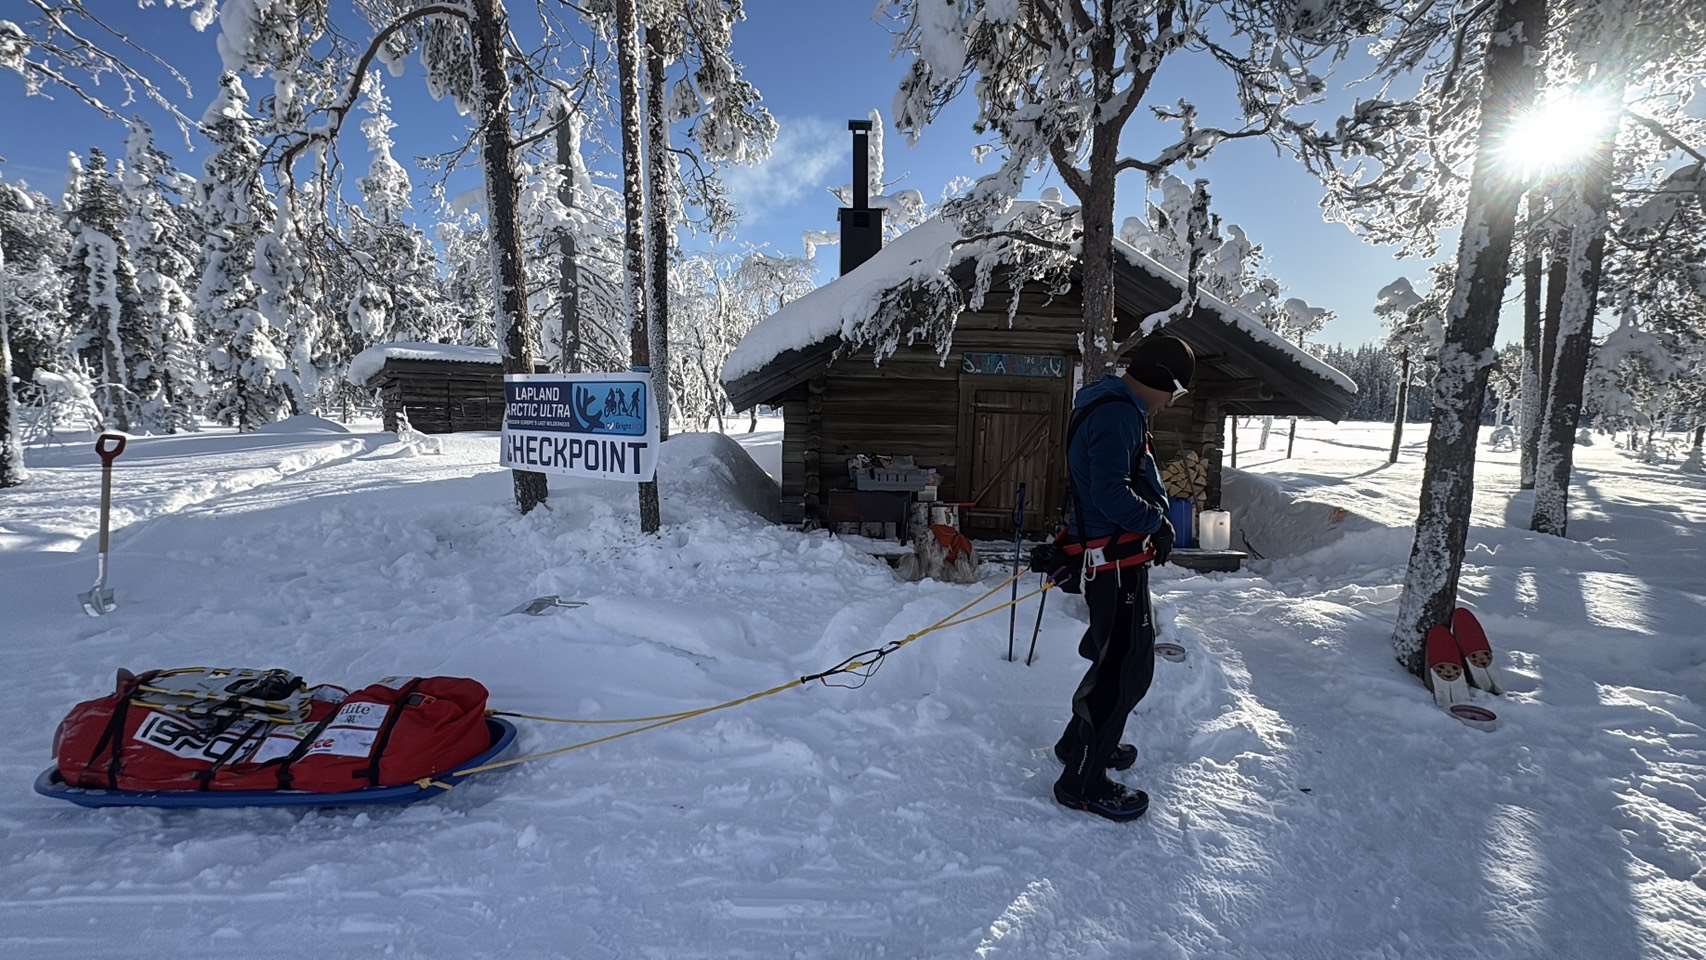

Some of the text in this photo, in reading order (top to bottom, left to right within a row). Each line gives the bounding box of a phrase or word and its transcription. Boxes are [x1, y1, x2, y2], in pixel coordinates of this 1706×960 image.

[515, 387, 560, 401] LAPLAND
[507, 402, 571, 418] ARCTIC ULTRA
